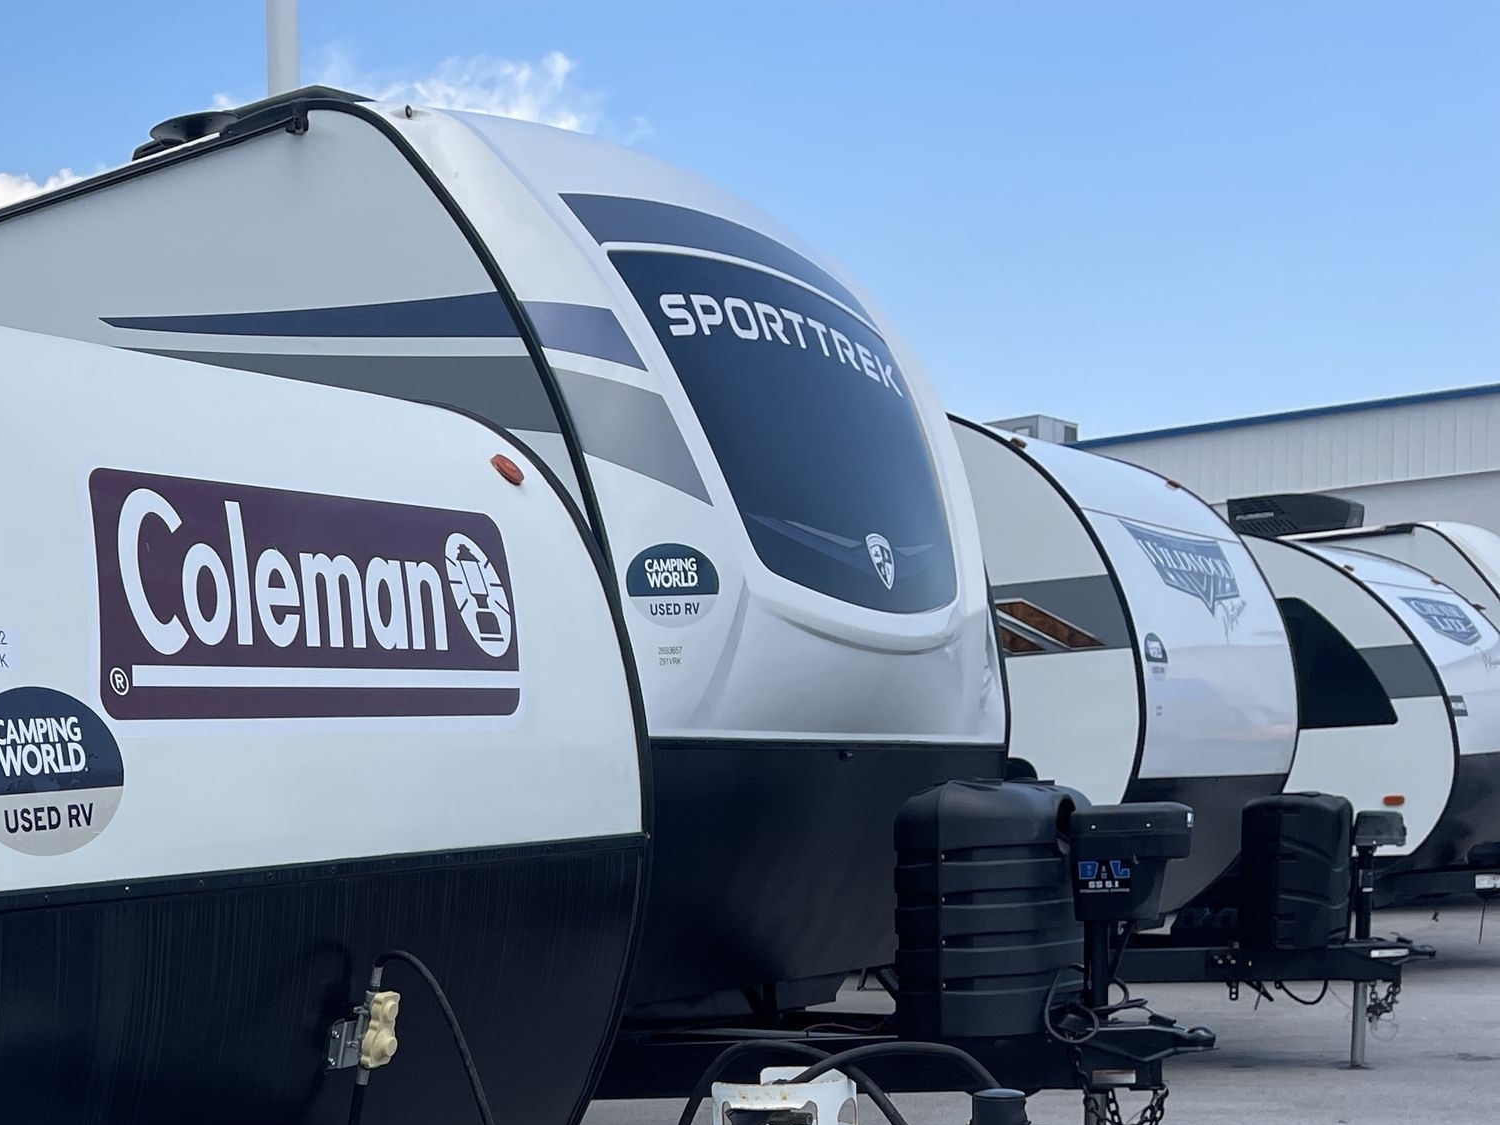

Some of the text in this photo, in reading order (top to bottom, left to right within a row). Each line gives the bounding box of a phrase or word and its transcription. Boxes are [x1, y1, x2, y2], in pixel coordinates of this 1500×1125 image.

[659, 293, 903, 397] SPORTTREK
[117, 488, 449, 655] Coleman
[644, 558, 697, 572] CAMPING
[1137, 539, 1235, 579] WILDWOOD
[647, 571, 698, 588] WORLD
[650, 602, 700, 616] USED RV
[4, 803, 94, 834] USED RV
